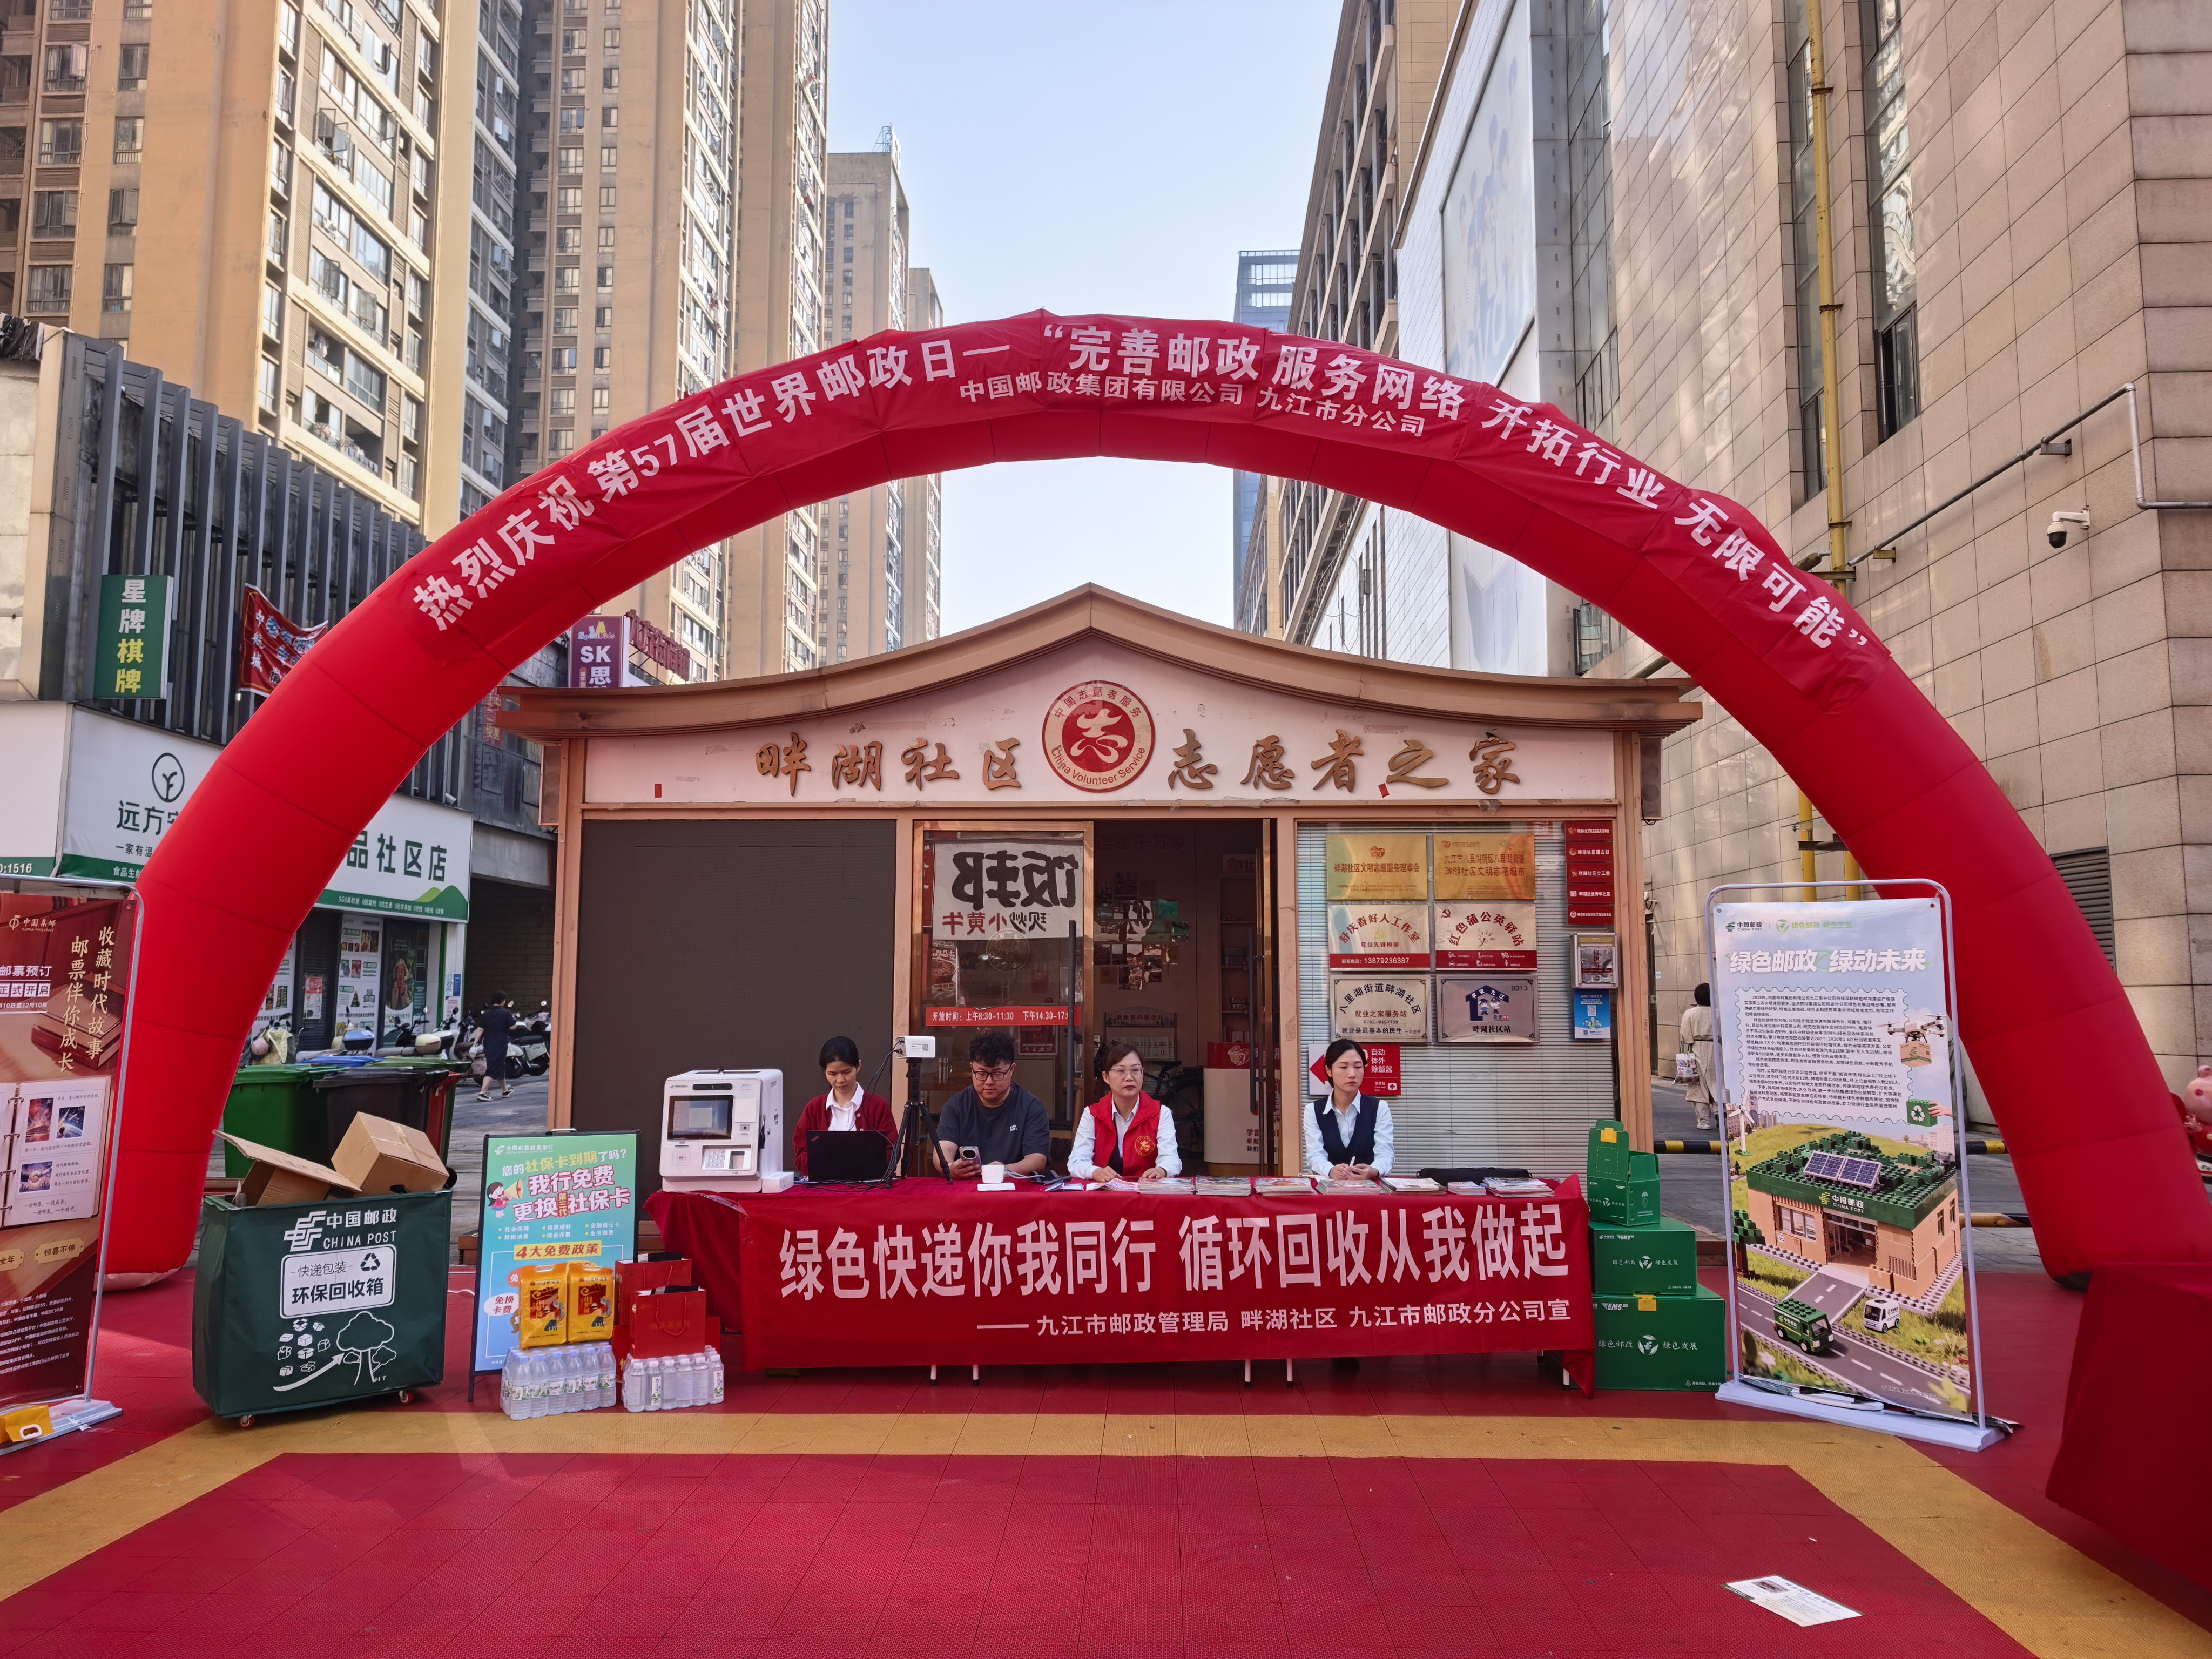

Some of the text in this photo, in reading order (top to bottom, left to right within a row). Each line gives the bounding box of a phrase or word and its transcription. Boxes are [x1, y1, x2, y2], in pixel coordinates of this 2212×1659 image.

[960, 371, 1426, 437] 中国邮政集团有限公司 九江市分公司
[413, 475, 595, 631] 热烈庆祝
[115, 579, 146, 693] 星牌棋牌
[580, 645, 611, 663] SK
[589, 666, 611, 687] 思
[1054, 687, 1142, 719] 中国志愿者服务
[756, 727, 1520, 797] 畔湖社区 志愿者之家
[1051, 745, 1145, 785] China Volunteer Service
[23, 918, 56, 927] 中国集邮
[1448, 911, 1525, 947] 红色蒲公英驿站
[0, 965, 52, 977] 邮票预订
[1729, 947, 1926, 974] 绿色邮政 绿动未来
[0, 984, 50, 997] 正式开启
[85, 926, 115, 1060] 收藏时代故事
[1339, 982, 1422, 1015] 八里湖街道畔湖社区
[58, 936, 88, 1073] 邮票伴你成长
[1354, 1010, 1407, 1018] 就业之家服务站
[1472, 1025, 1511, 1033] 畔湖社区站
[528, 1164, 615, 1196] 我行免费
[1832, 1194, 1864, 1209] 中国邮政
[1851, 1206, 1864, 1214] POST
[326, 1208, 397, 1229] 中国邮政
[44, 1243, 76, 1257] 惊喜不停
[323, 1230, 397, 1249] CHINA POST
[515, 1243, 600, 1259] 4大免费政策
[779, 1202, 1570, 1301] 绿色快递你我同行 循环回收从我做起
[291, 1277, 384, 1305] 环保回收箱
[495, 1296, 514, 1304] 免换
[493, 1305, 512, 1314] 卡费
[1240, 1307, 1338, 1331] 畔湖社区
[1348, 1298, 1572, 1328] 九江市邮政分公司宣
[1607, 1303, 1623, 1311] EMS
[1598, 1339, 1698, 1351] 绿色邮政 绿色发展
